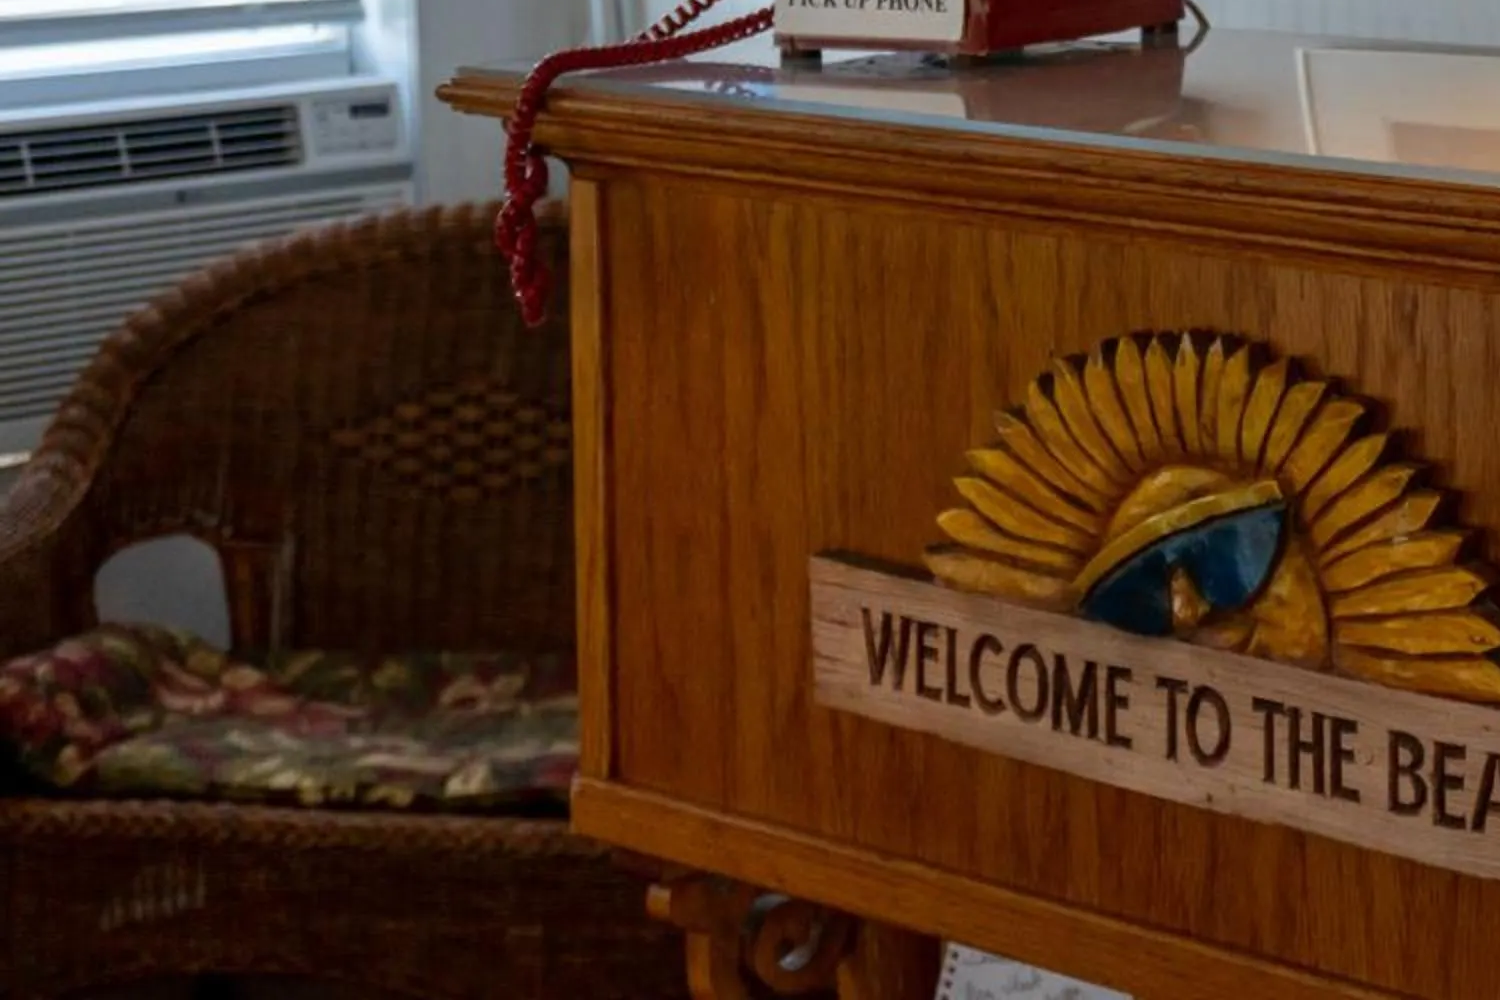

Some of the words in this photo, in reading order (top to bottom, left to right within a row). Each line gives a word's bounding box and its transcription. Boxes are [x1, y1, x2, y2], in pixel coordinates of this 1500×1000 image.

[861, 606, 1134, 750] WELCOME
[1155, 675, 1231, 768] TO
[1251, 696, 1361, 803] THE
